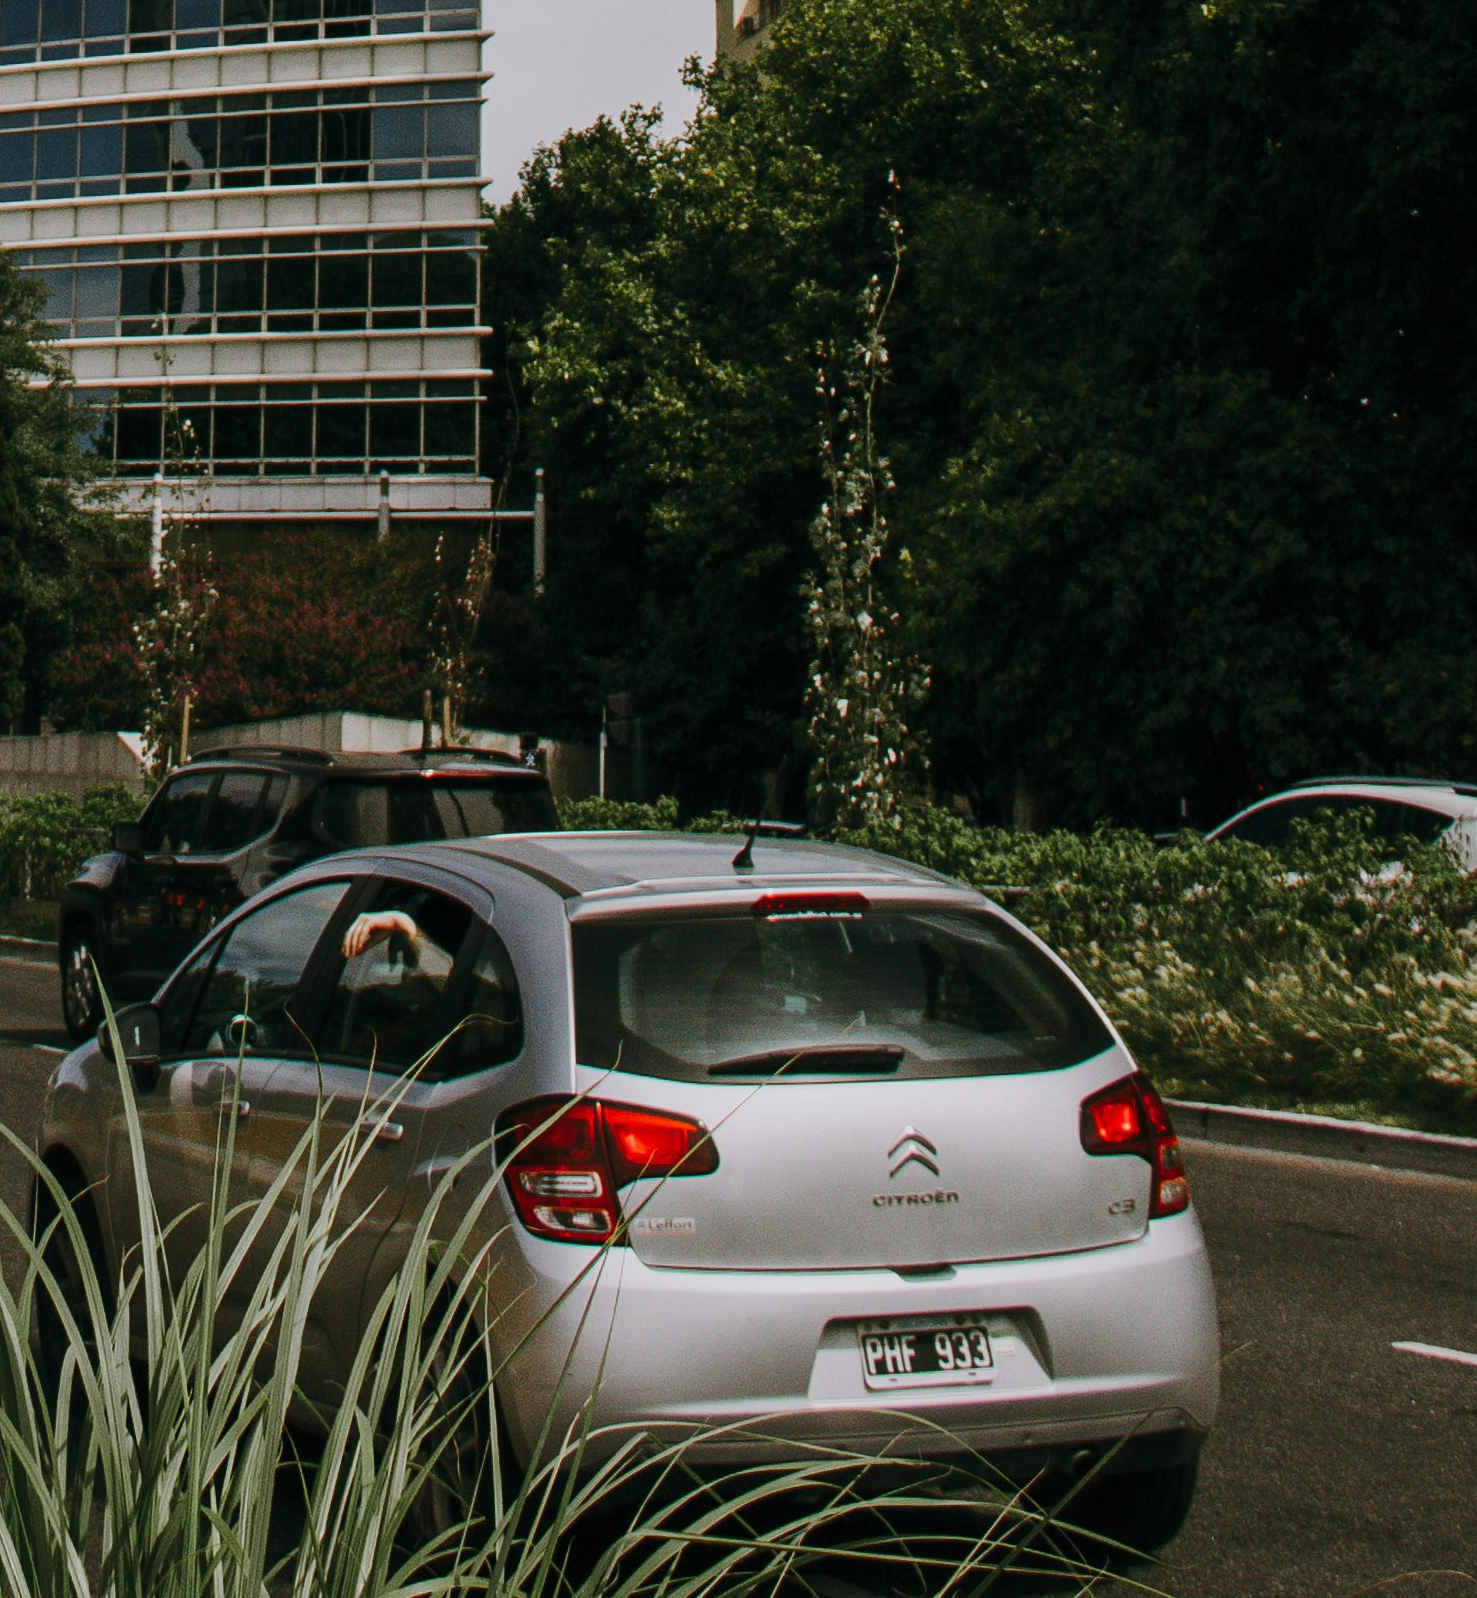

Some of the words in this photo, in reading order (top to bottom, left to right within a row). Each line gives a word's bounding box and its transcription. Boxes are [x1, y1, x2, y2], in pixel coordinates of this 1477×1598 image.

[1108, 1198, 1136, 1215] C3
[865, 1334, 916, 1375] PHF
[934, 1329, 991, 1371] 933
